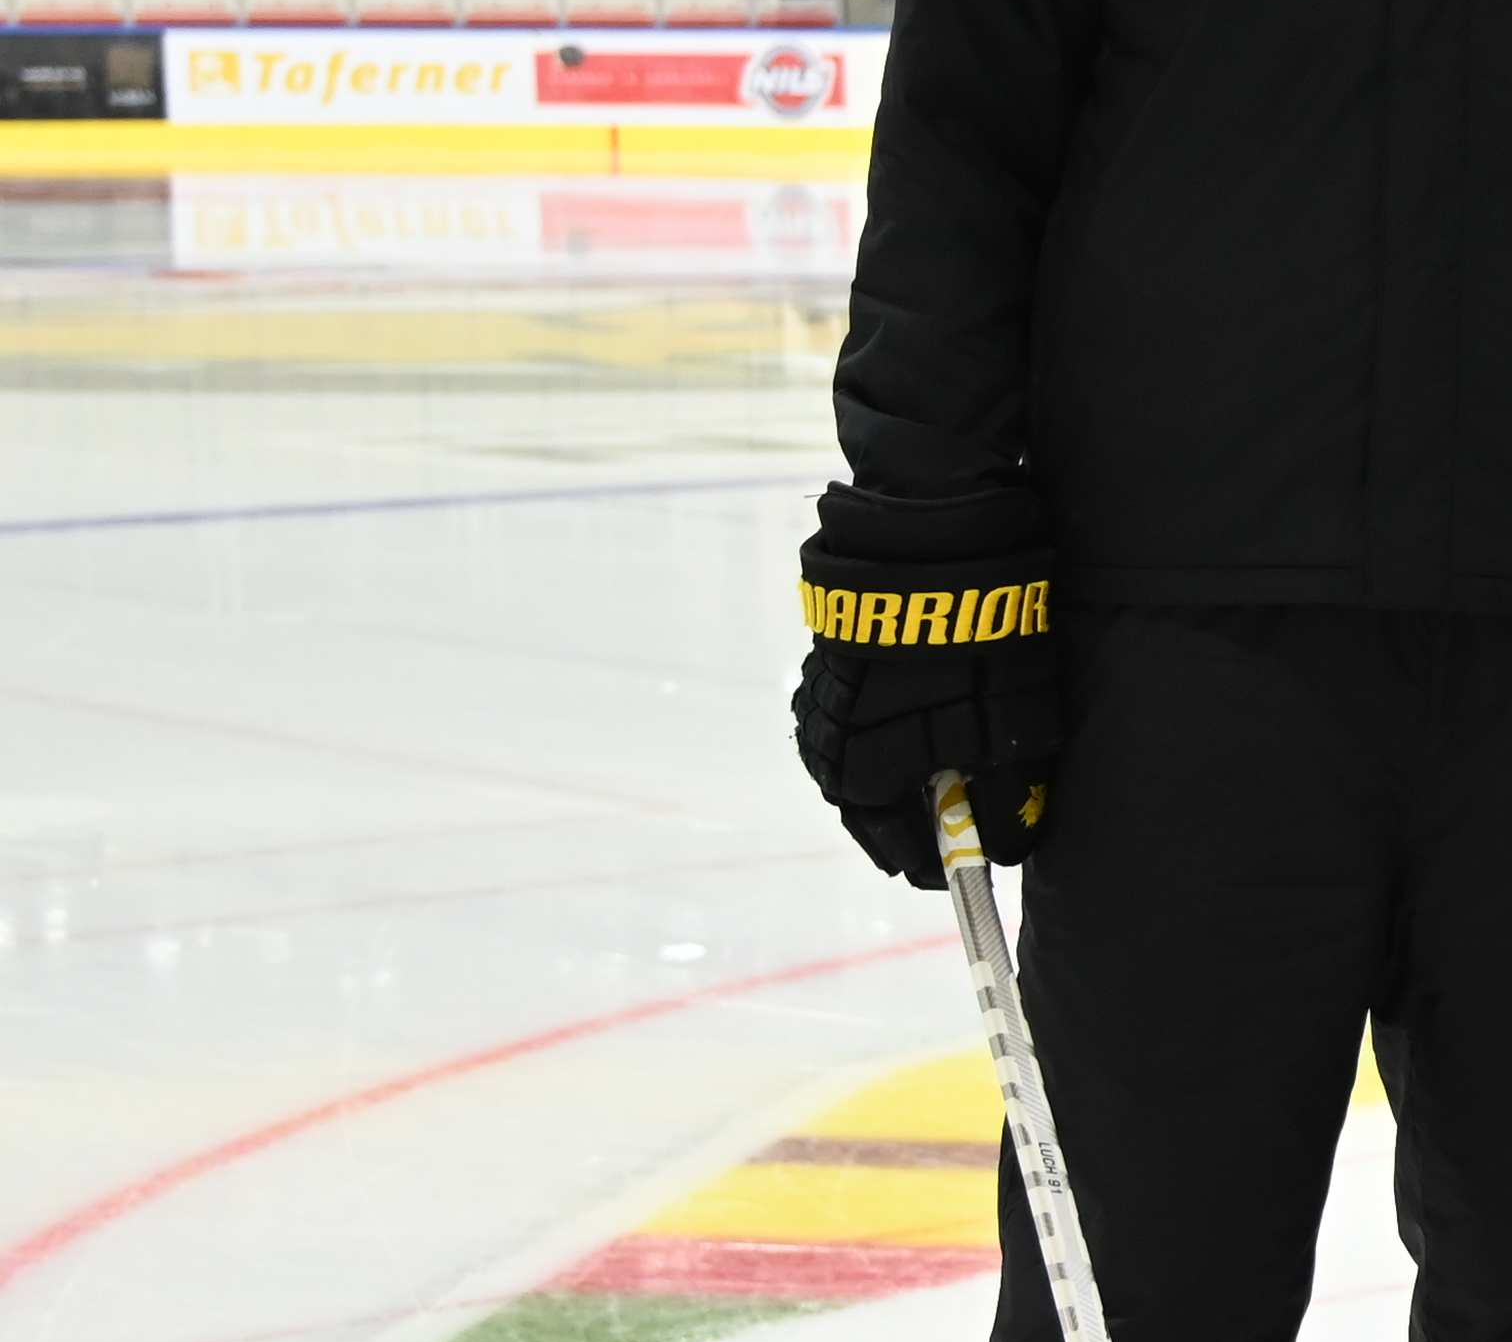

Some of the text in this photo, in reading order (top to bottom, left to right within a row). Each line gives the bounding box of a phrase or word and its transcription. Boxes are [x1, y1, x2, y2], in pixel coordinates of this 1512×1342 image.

[254, 50, 512, 105] Taferner
[799, 580, 1050, 646] WARRIOR
[1037, 1139, 1063, 1196] LUCH 91
